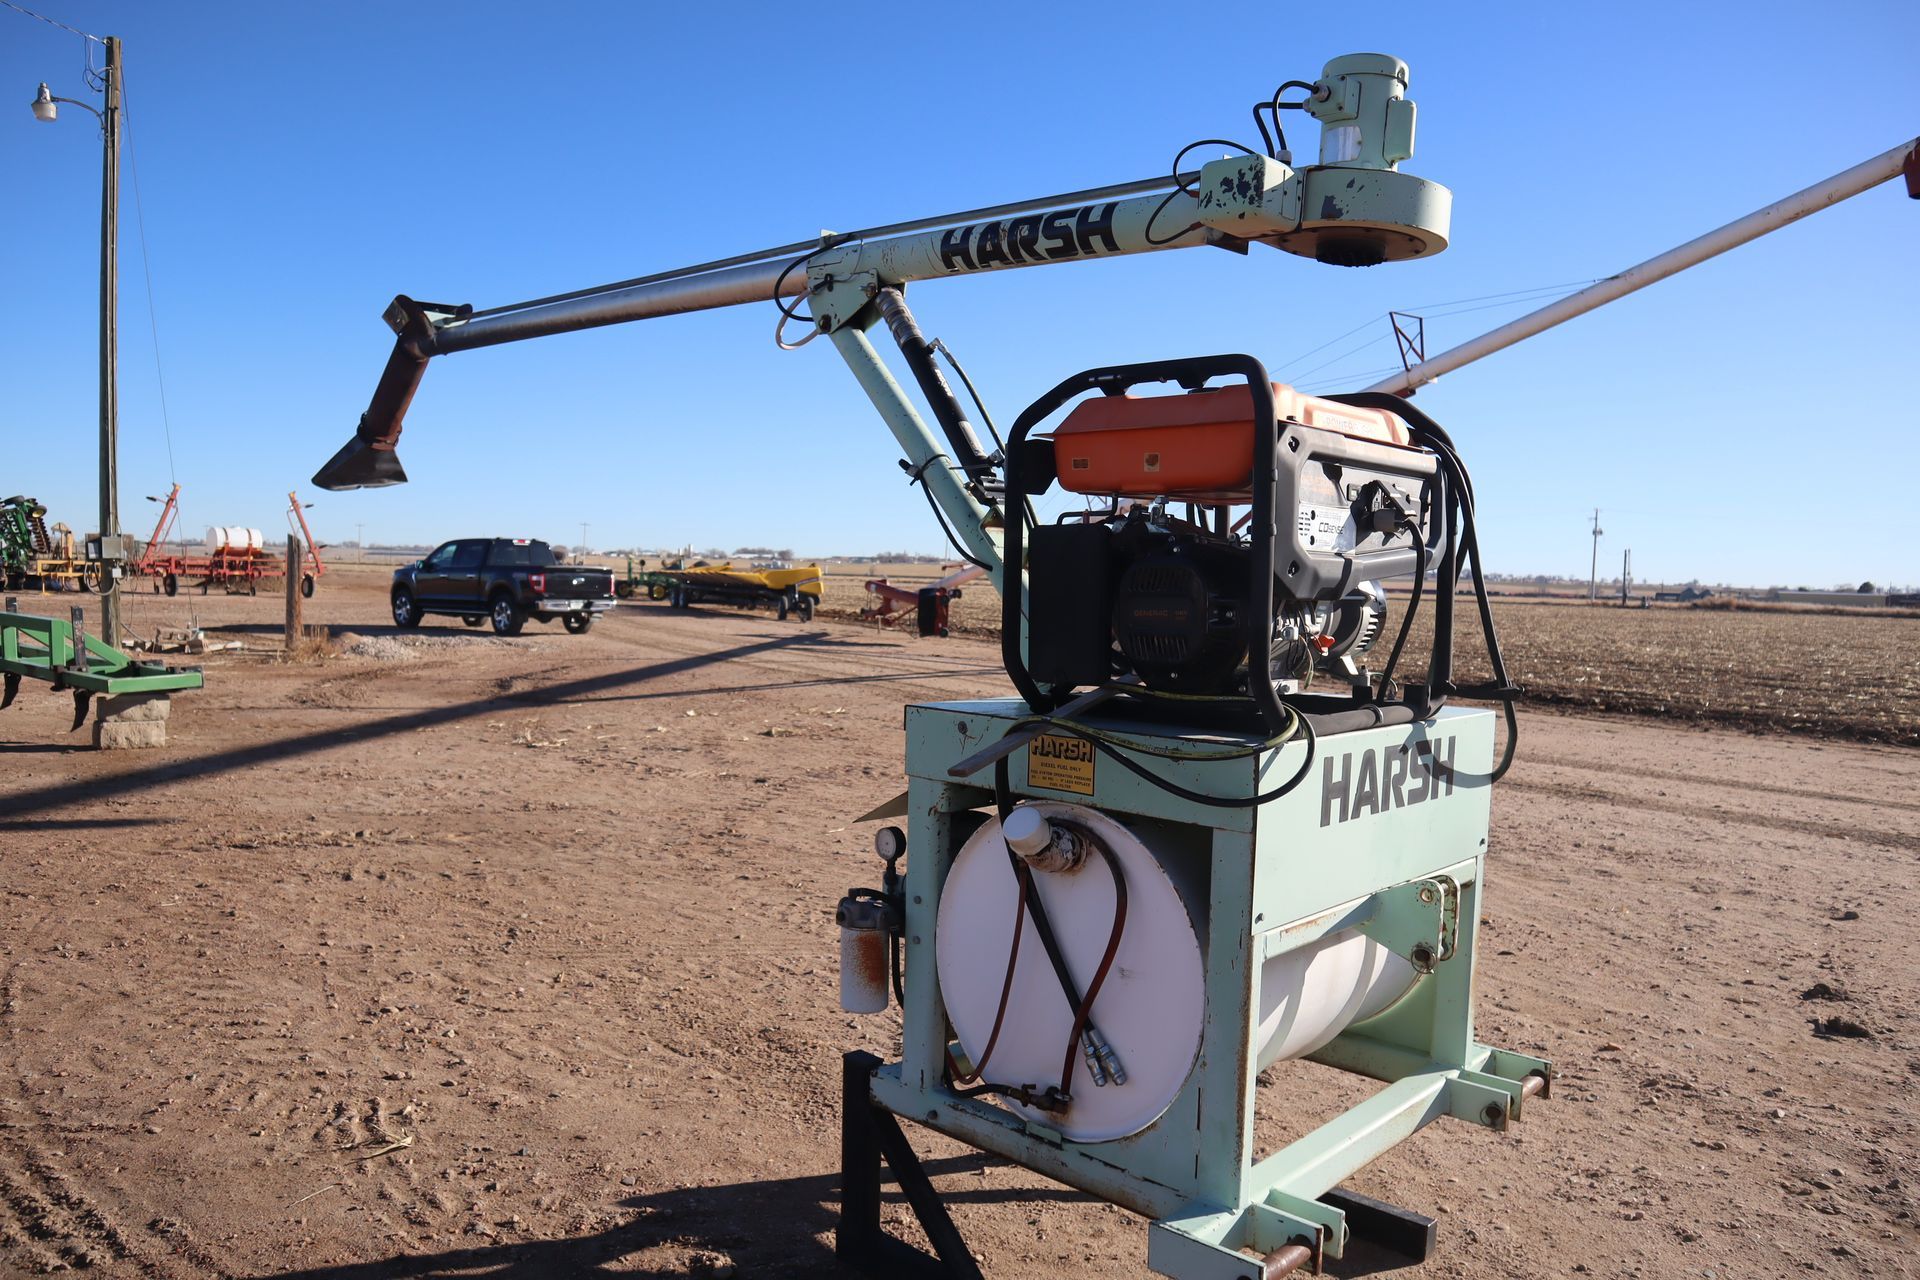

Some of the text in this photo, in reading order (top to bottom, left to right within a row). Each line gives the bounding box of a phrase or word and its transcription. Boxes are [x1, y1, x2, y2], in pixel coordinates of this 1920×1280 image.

[940, 202, 1120, 271] HARSH
[1030, 736, 1093, 762] HARSH
[1320, 736, 1456, 827] HARSH
